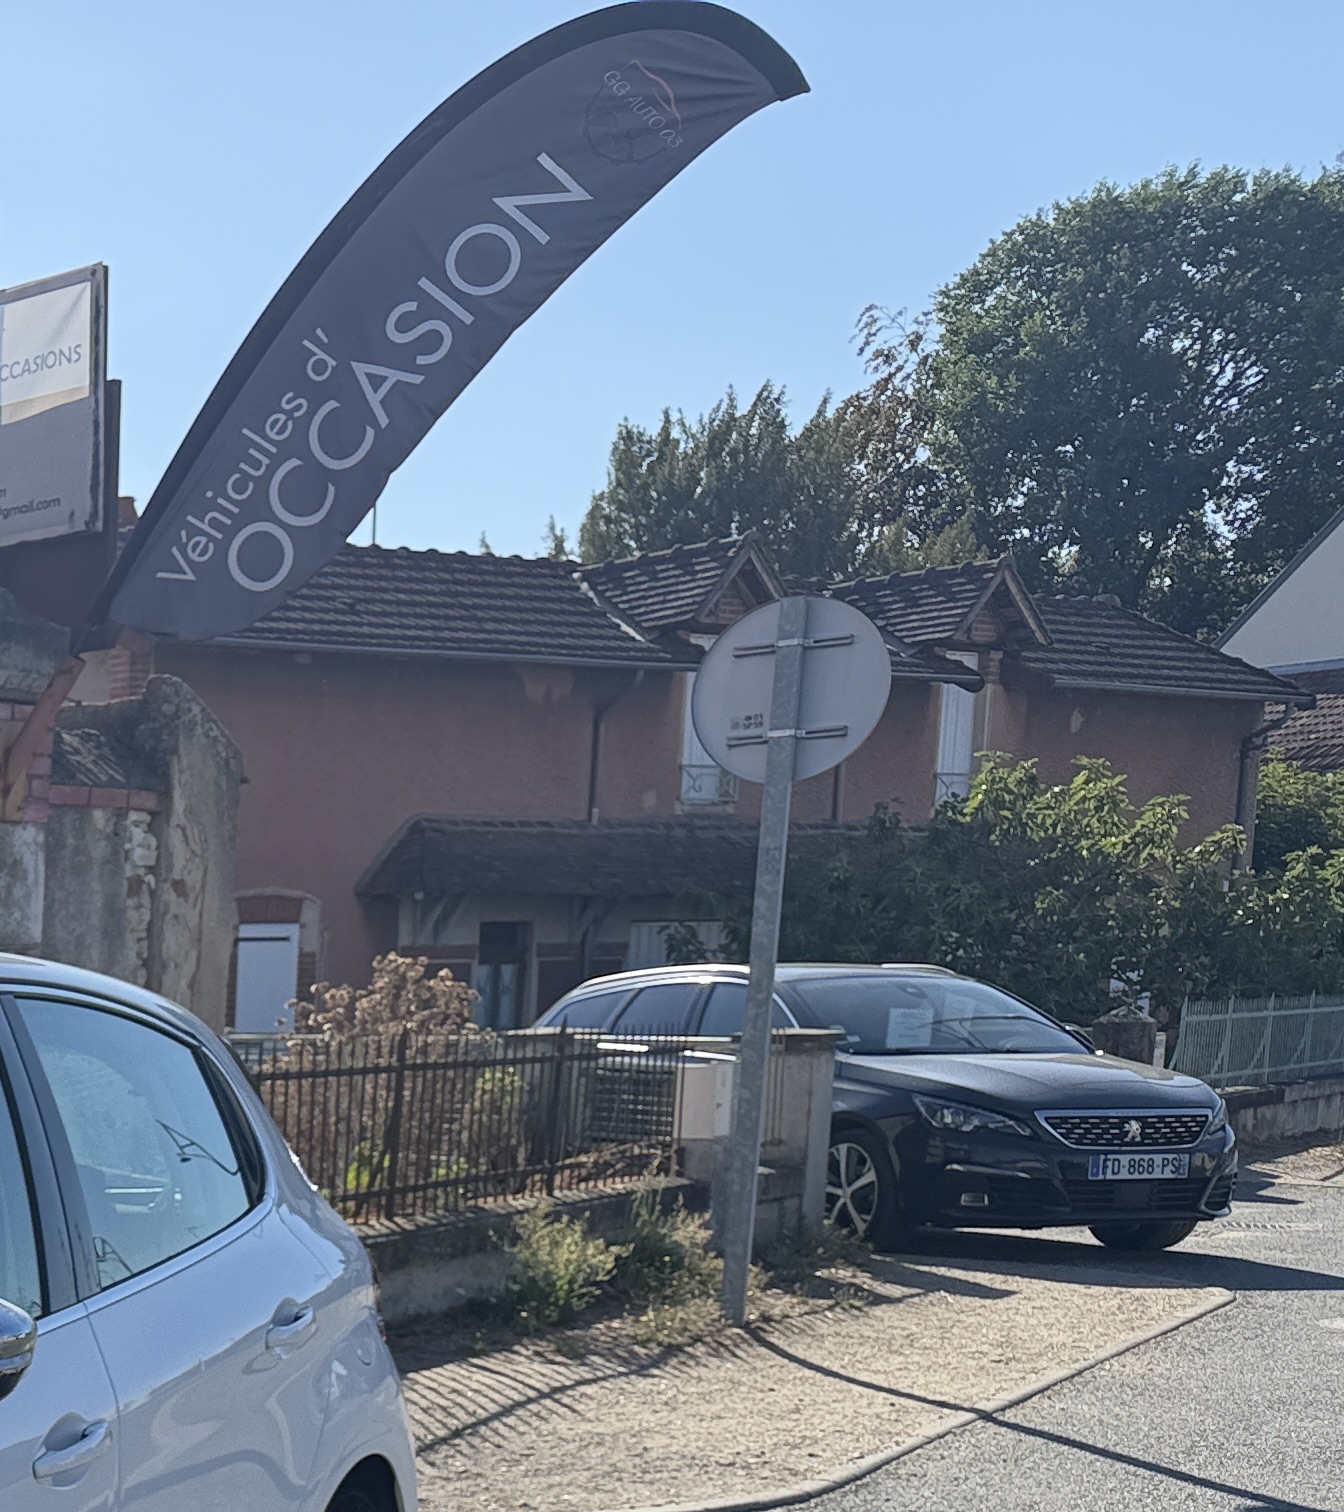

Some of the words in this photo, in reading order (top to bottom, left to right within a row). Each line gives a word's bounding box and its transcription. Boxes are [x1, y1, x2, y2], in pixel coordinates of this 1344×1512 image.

[603, 70, 632, 97] GG
[624, 96, 666, 130] AUTO
[659, 129, 684, 148] 03
[155, 388, 311, 588] Véhicules
[302, 326, 339, 383] d'
[227, 151, 595, 592] OCCASION
